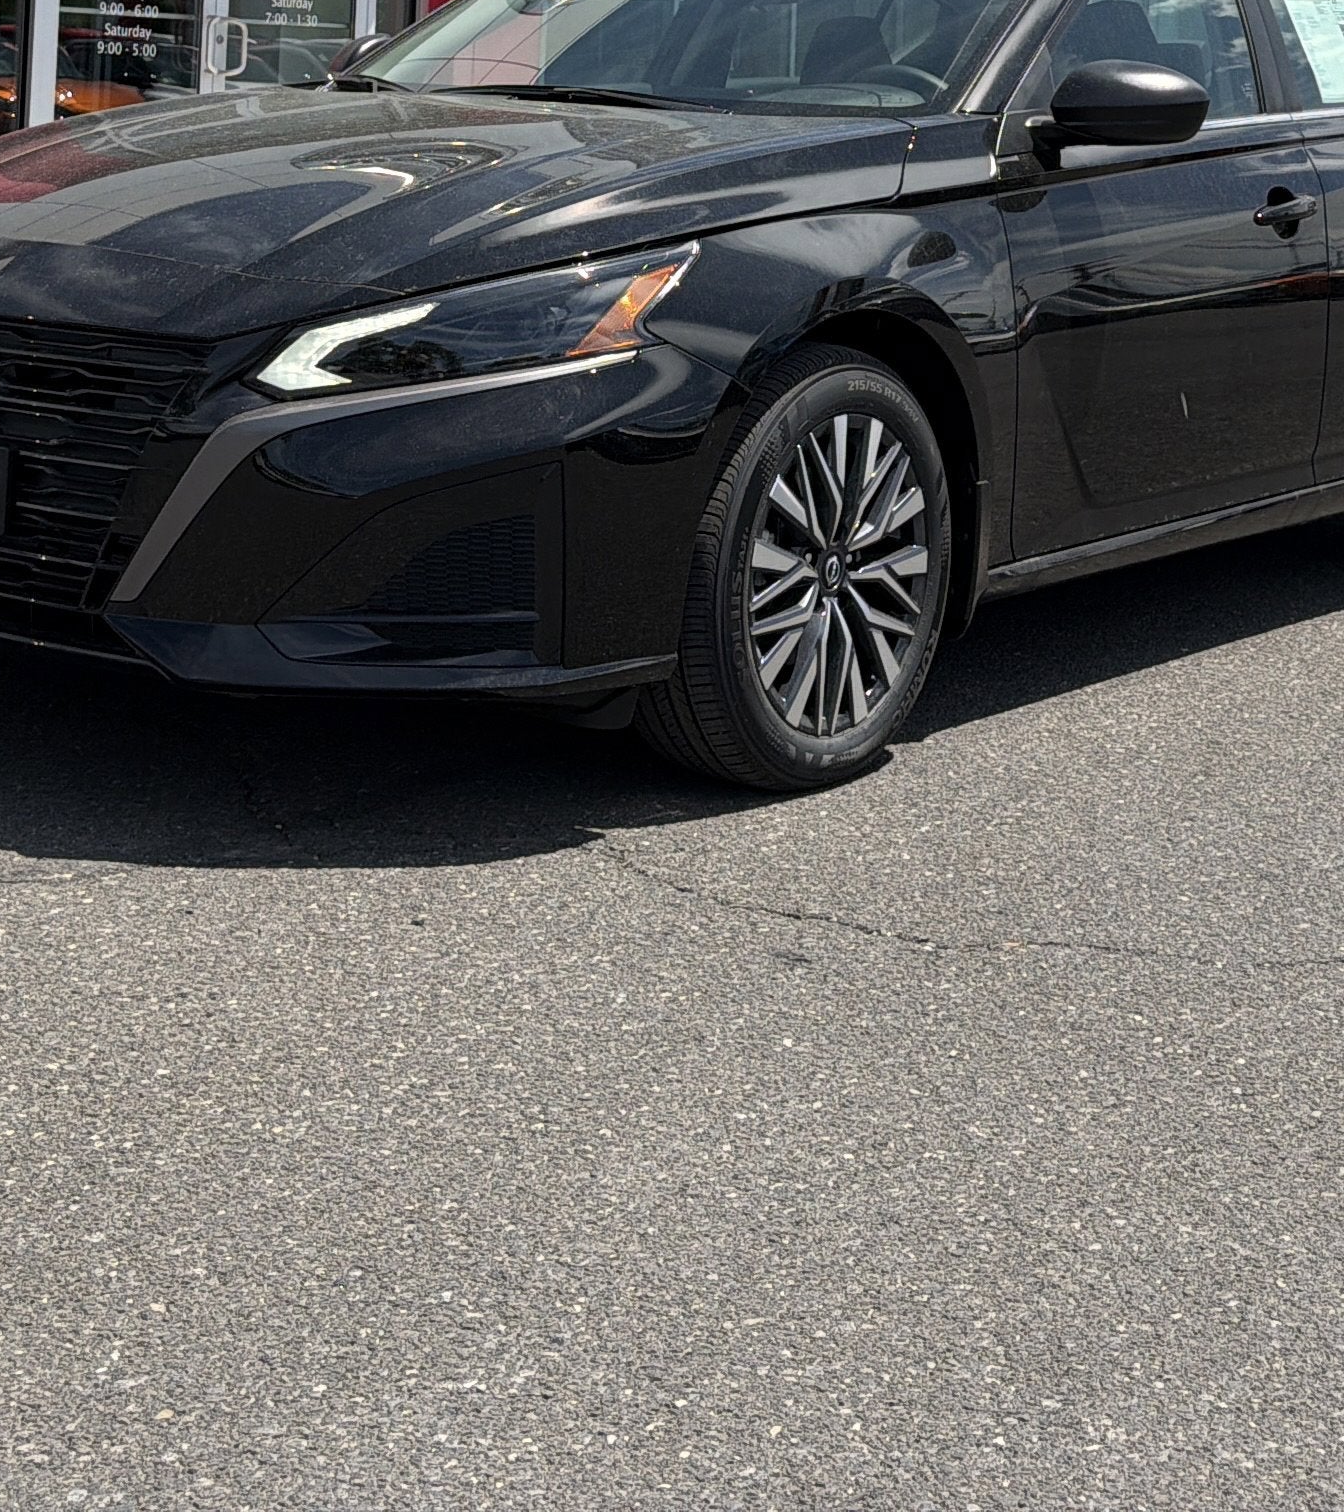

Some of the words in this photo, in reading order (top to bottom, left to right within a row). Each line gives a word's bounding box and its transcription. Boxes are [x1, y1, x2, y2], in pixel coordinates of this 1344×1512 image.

[99, 1, 125, 16] 9:00
[134, 4, 159, 18] 6:00
[265, 12, 288, 25] 7:00
[296, 14, 318, 27] 1:30
[103, 22, 152, 41] Saturday
[97, 41, 123, 55] 9:00
[132, 43, 157, 57] 5:00
[847, 379, 883, 394] 215/55
